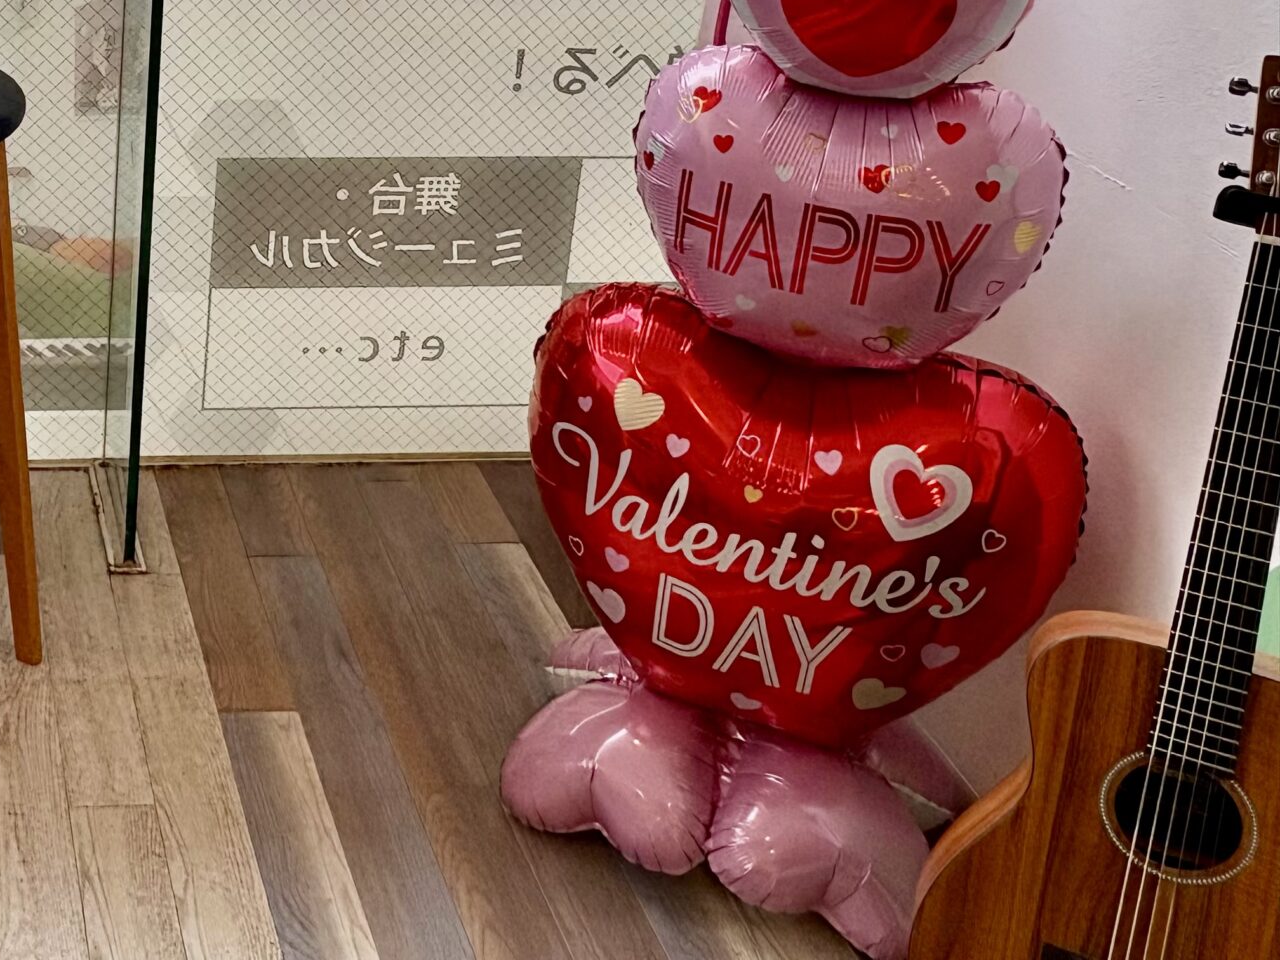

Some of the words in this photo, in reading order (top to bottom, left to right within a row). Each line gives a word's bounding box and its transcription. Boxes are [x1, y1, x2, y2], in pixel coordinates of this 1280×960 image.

[673, 168, 993, 314] HAPPY
[551, 421, 988, 620] Valentine's
[651, 571, 854, 696] DAY
